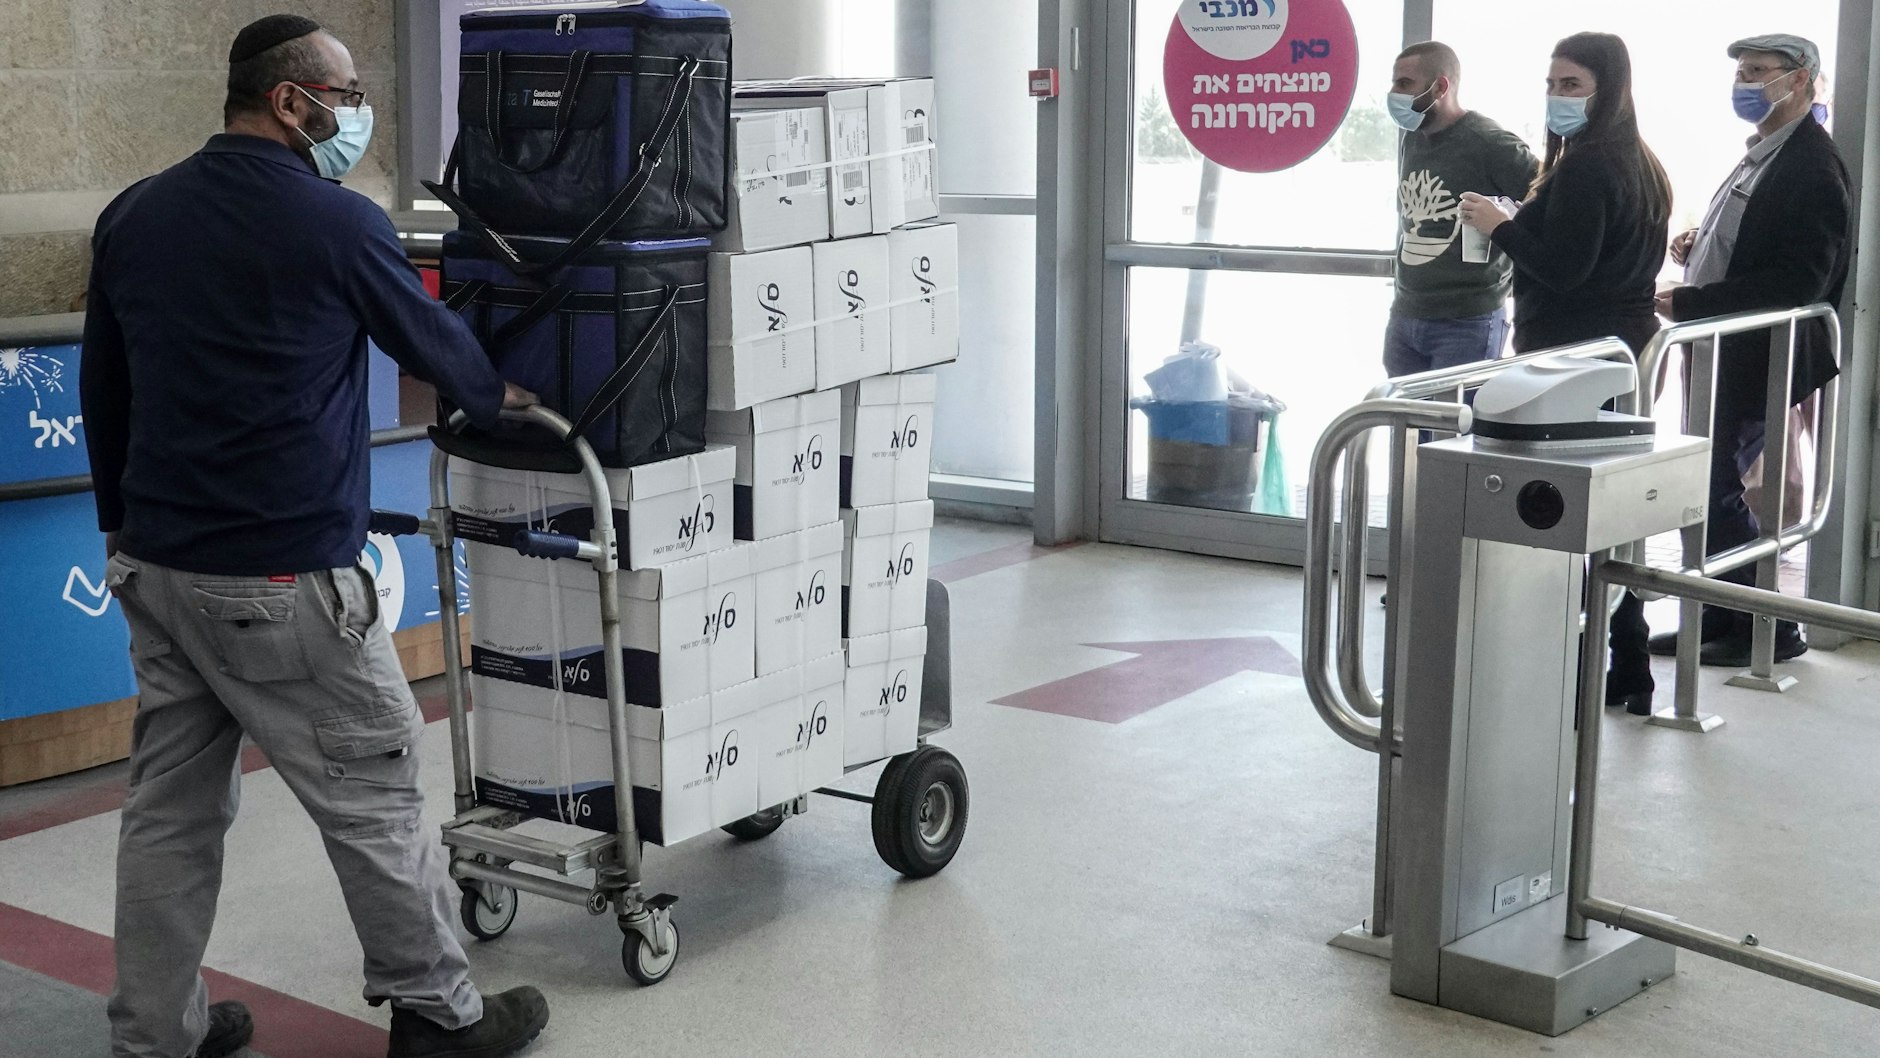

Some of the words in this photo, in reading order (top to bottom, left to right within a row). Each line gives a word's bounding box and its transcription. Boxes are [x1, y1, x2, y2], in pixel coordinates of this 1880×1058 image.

[1199, 0, 1259, 18] מכבי
[1261, 23, 1281, 31] קבוצת
[1290, 38, 1330, 64] כאן
[1192, 73, 1230, 94] את
[1236, 71, 1332, 93] מנצחים
[1191, 102, 1316, 135] הקורונה
[564, 658, 590, 687] סלא
